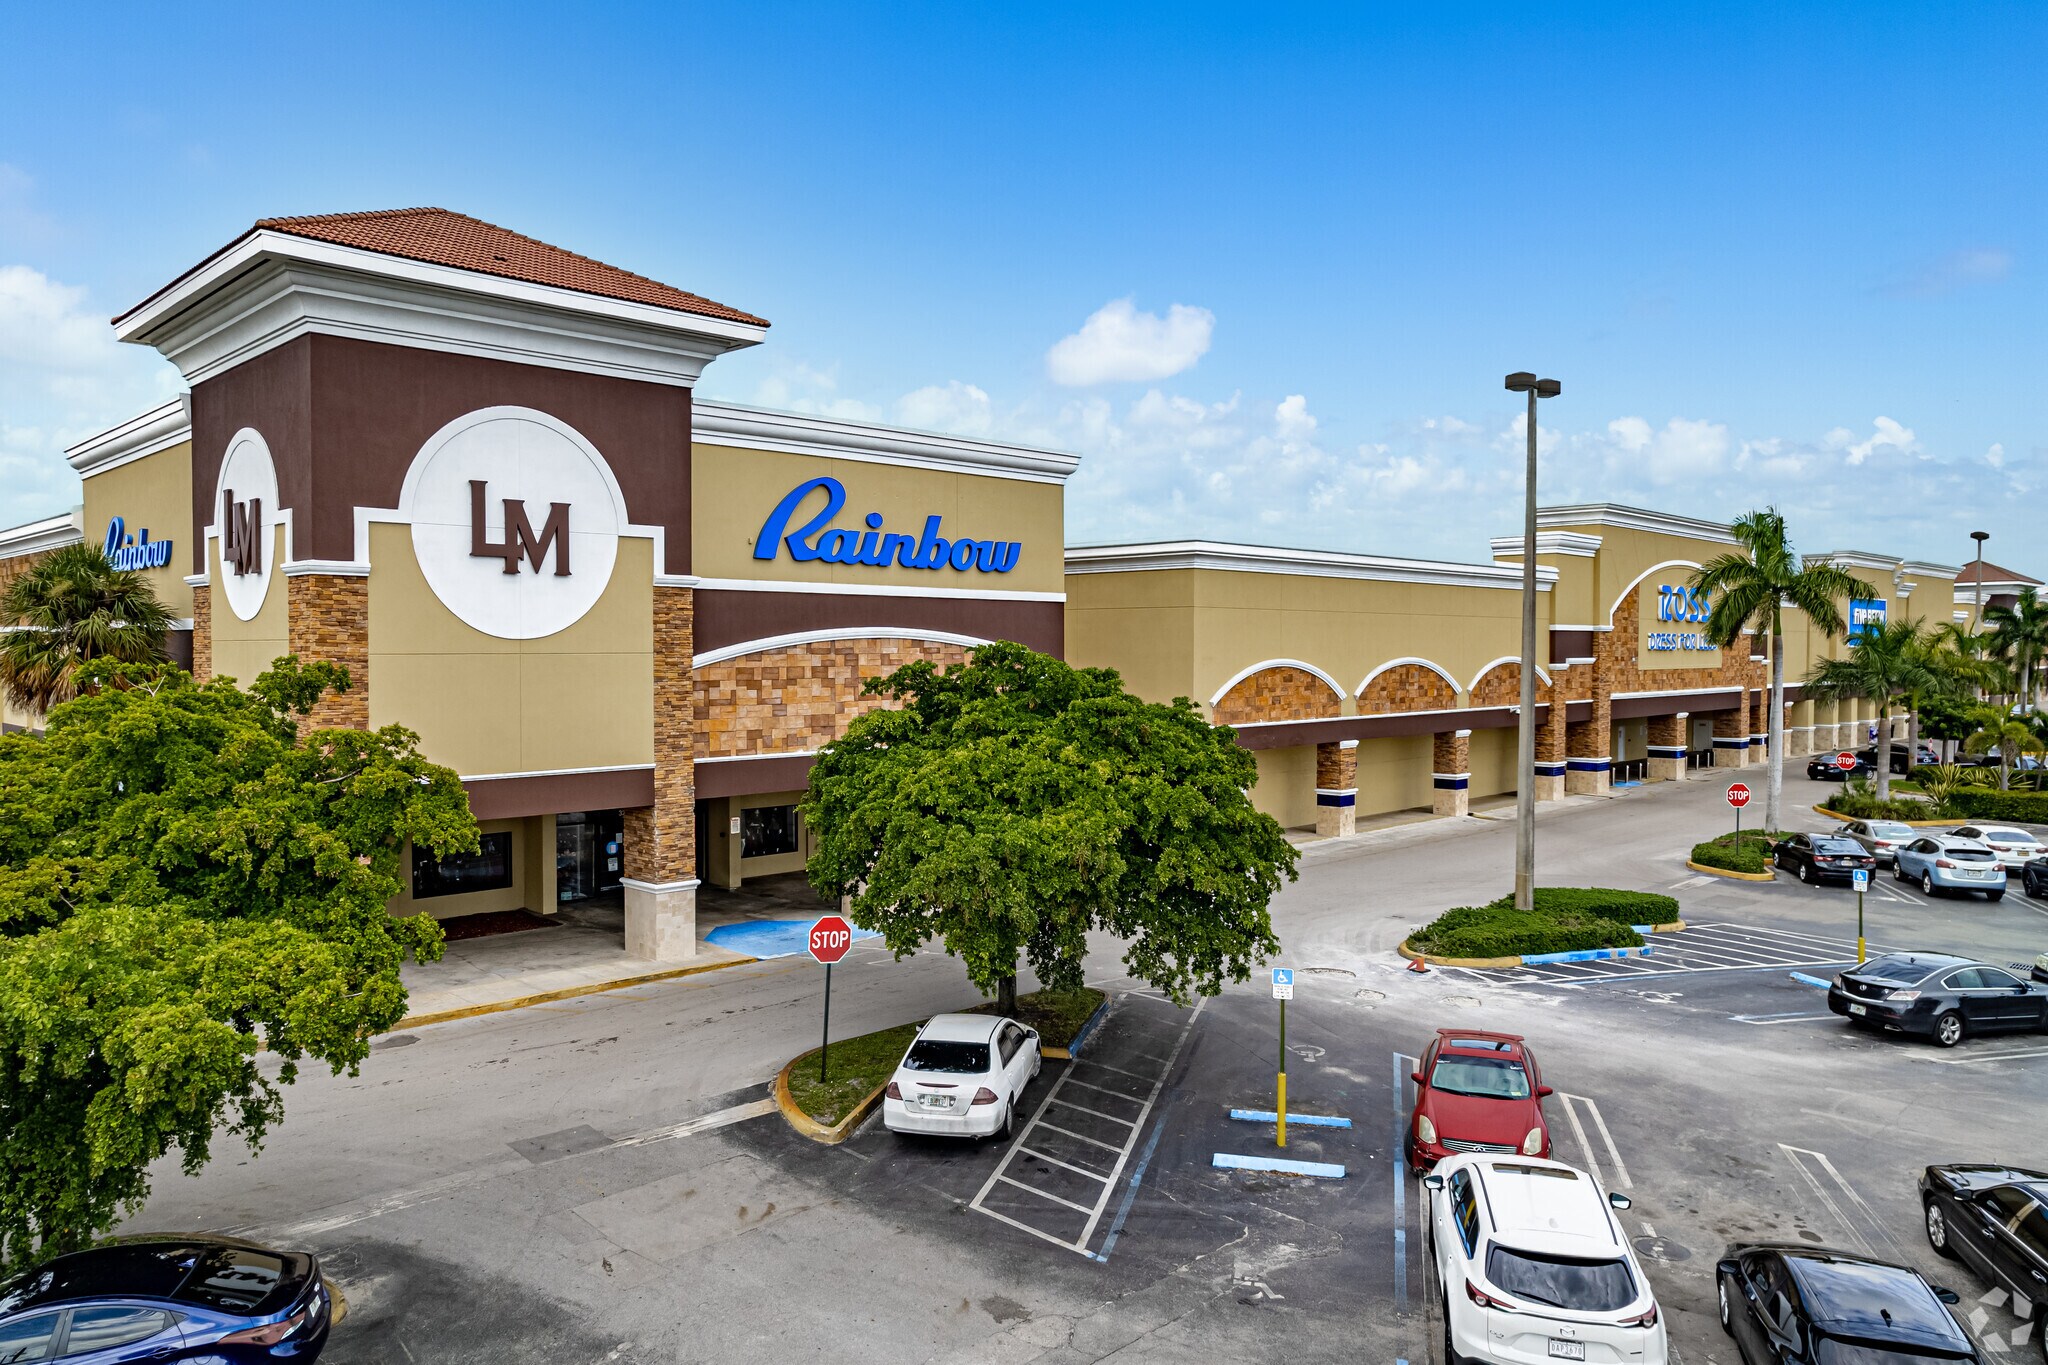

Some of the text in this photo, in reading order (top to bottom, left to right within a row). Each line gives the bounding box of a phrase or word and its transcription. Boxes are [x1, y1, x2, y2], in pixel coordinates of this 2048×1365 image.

[224, 489, 262, 576] LM
[469, 480, 572, 576] LM
[753, 476, 1021, 573] Rainbow
[1648, 633, 1676, 650] DRESS
[1678, 633, 1696, 650] FOR
[1837, 755, 1855, 765] STOP
[1728, 789, 1749, 800] STOP
[811, 930, 849, 949] STOP
